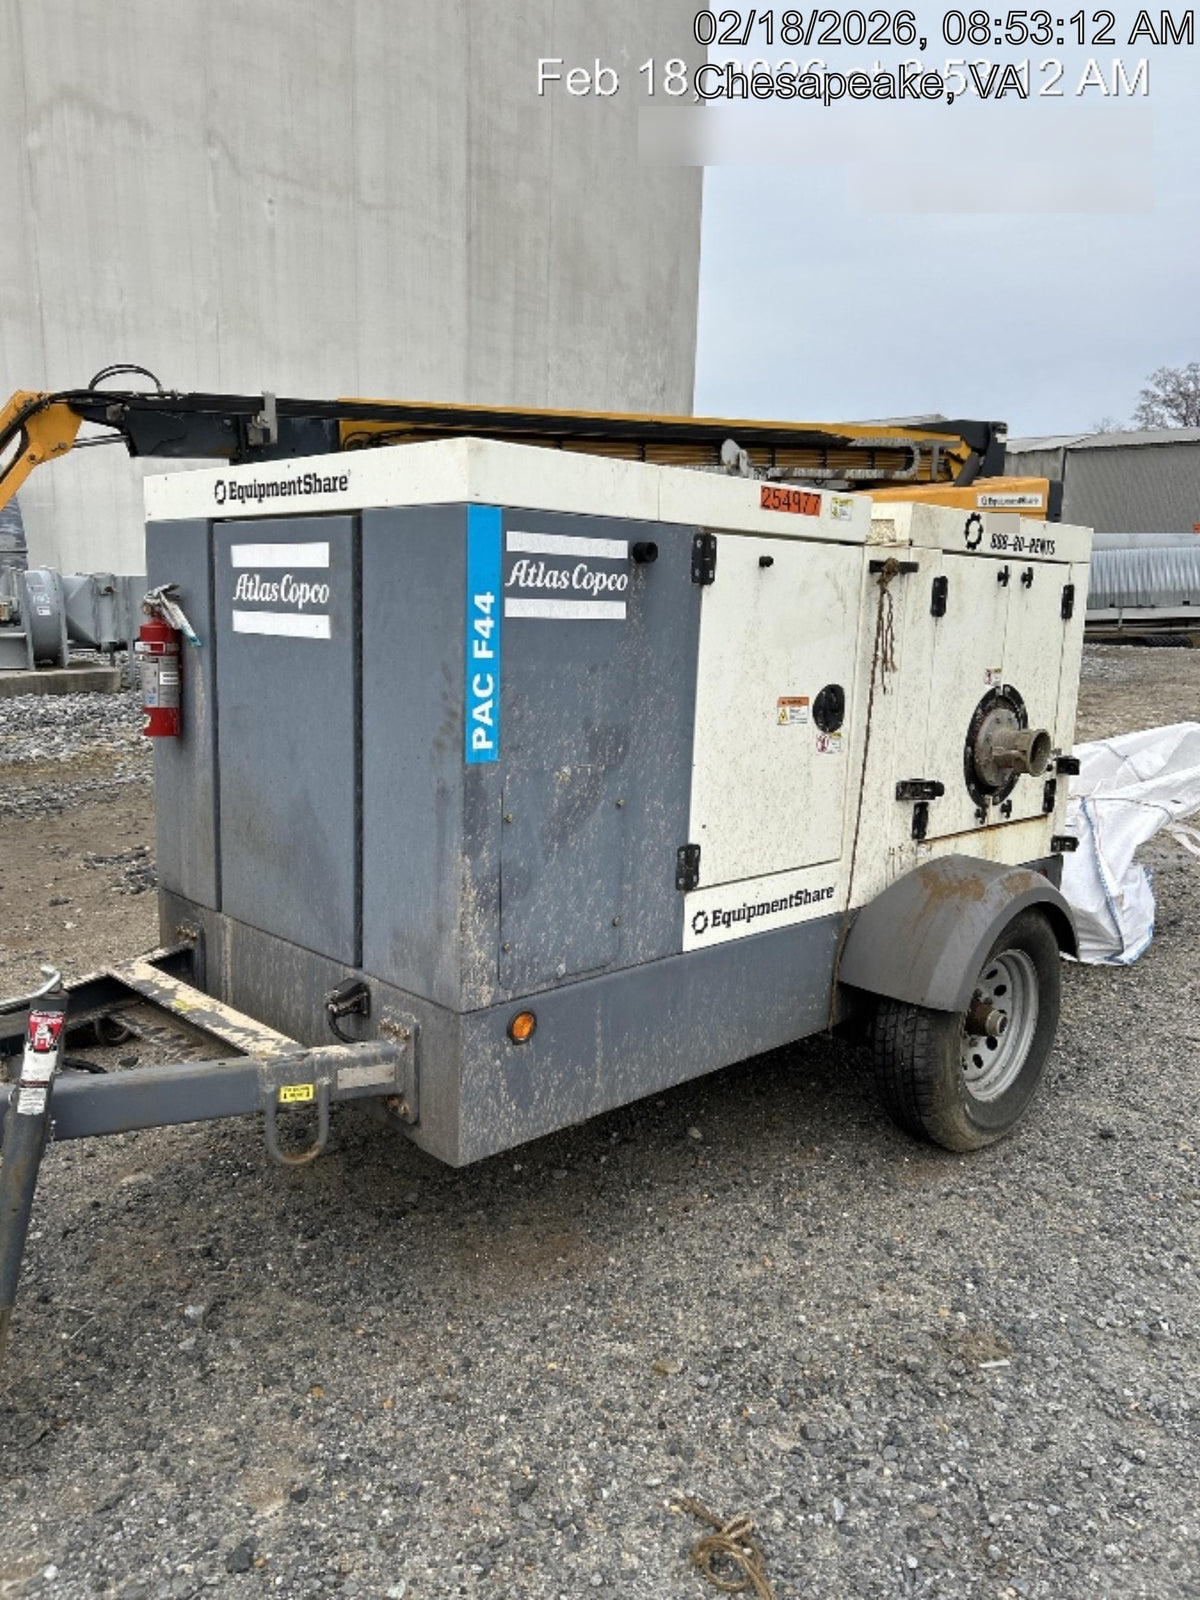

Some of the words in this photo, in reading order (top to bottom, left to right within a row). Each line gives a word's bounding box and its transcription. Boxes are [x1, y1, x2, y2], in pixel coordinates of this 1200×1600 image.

[228, 472, 349, 504] EquipmentShare
[761, 486, 821, 516] 254977
[232, 573, 280, 602] Atlas
[280, 573, 330, 610] Copco
[504, 559, 570, 590] Atlas
[571, 562, 629, 597] Copco
[472, 591, 496, 659] F44
[471, 672, 495, 750] PAC
[710, 885, 835, 929] EquipmentShare
